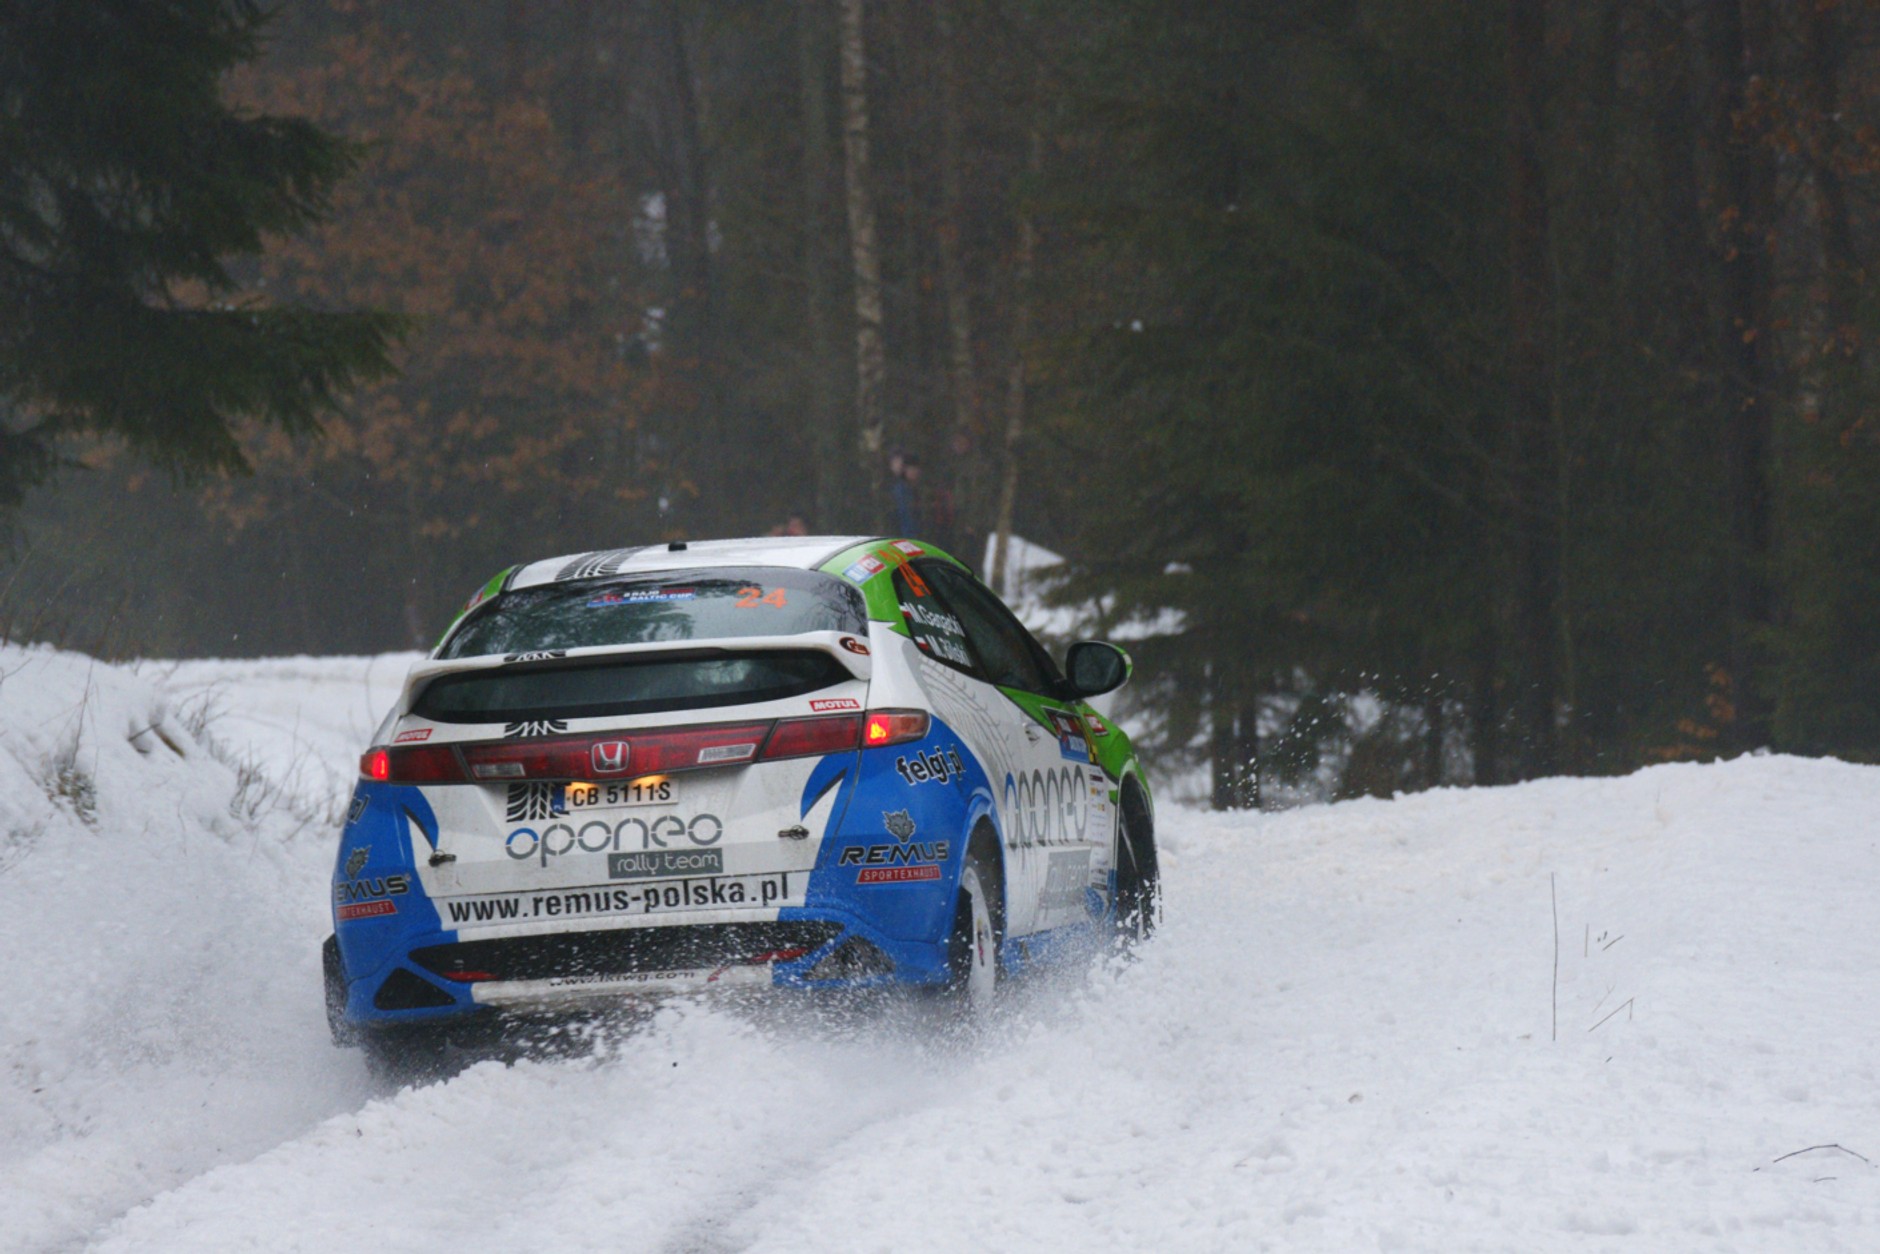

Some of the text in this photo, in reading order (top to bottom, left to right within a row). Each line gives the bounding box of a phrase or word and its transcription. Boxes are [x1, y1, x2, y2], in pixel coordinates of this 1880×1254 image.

[735, 587, 787, 609] 24
[813, 699, 858, 710] MOTUL
[896, 744, 966, 785] felgi.pl
[572, 781, 671, 807] CB 5111S
[505, 813, 723, 868] oponeo
[616, 852, 719, 875] rally team
[838, 841, 949, 866] REMUS
[863, 867, 938, 881] SPORTEXHAUST
[336, 876, 409, 901] EMUS
[449, 871, 789, 922] www.remus-polska.pl
